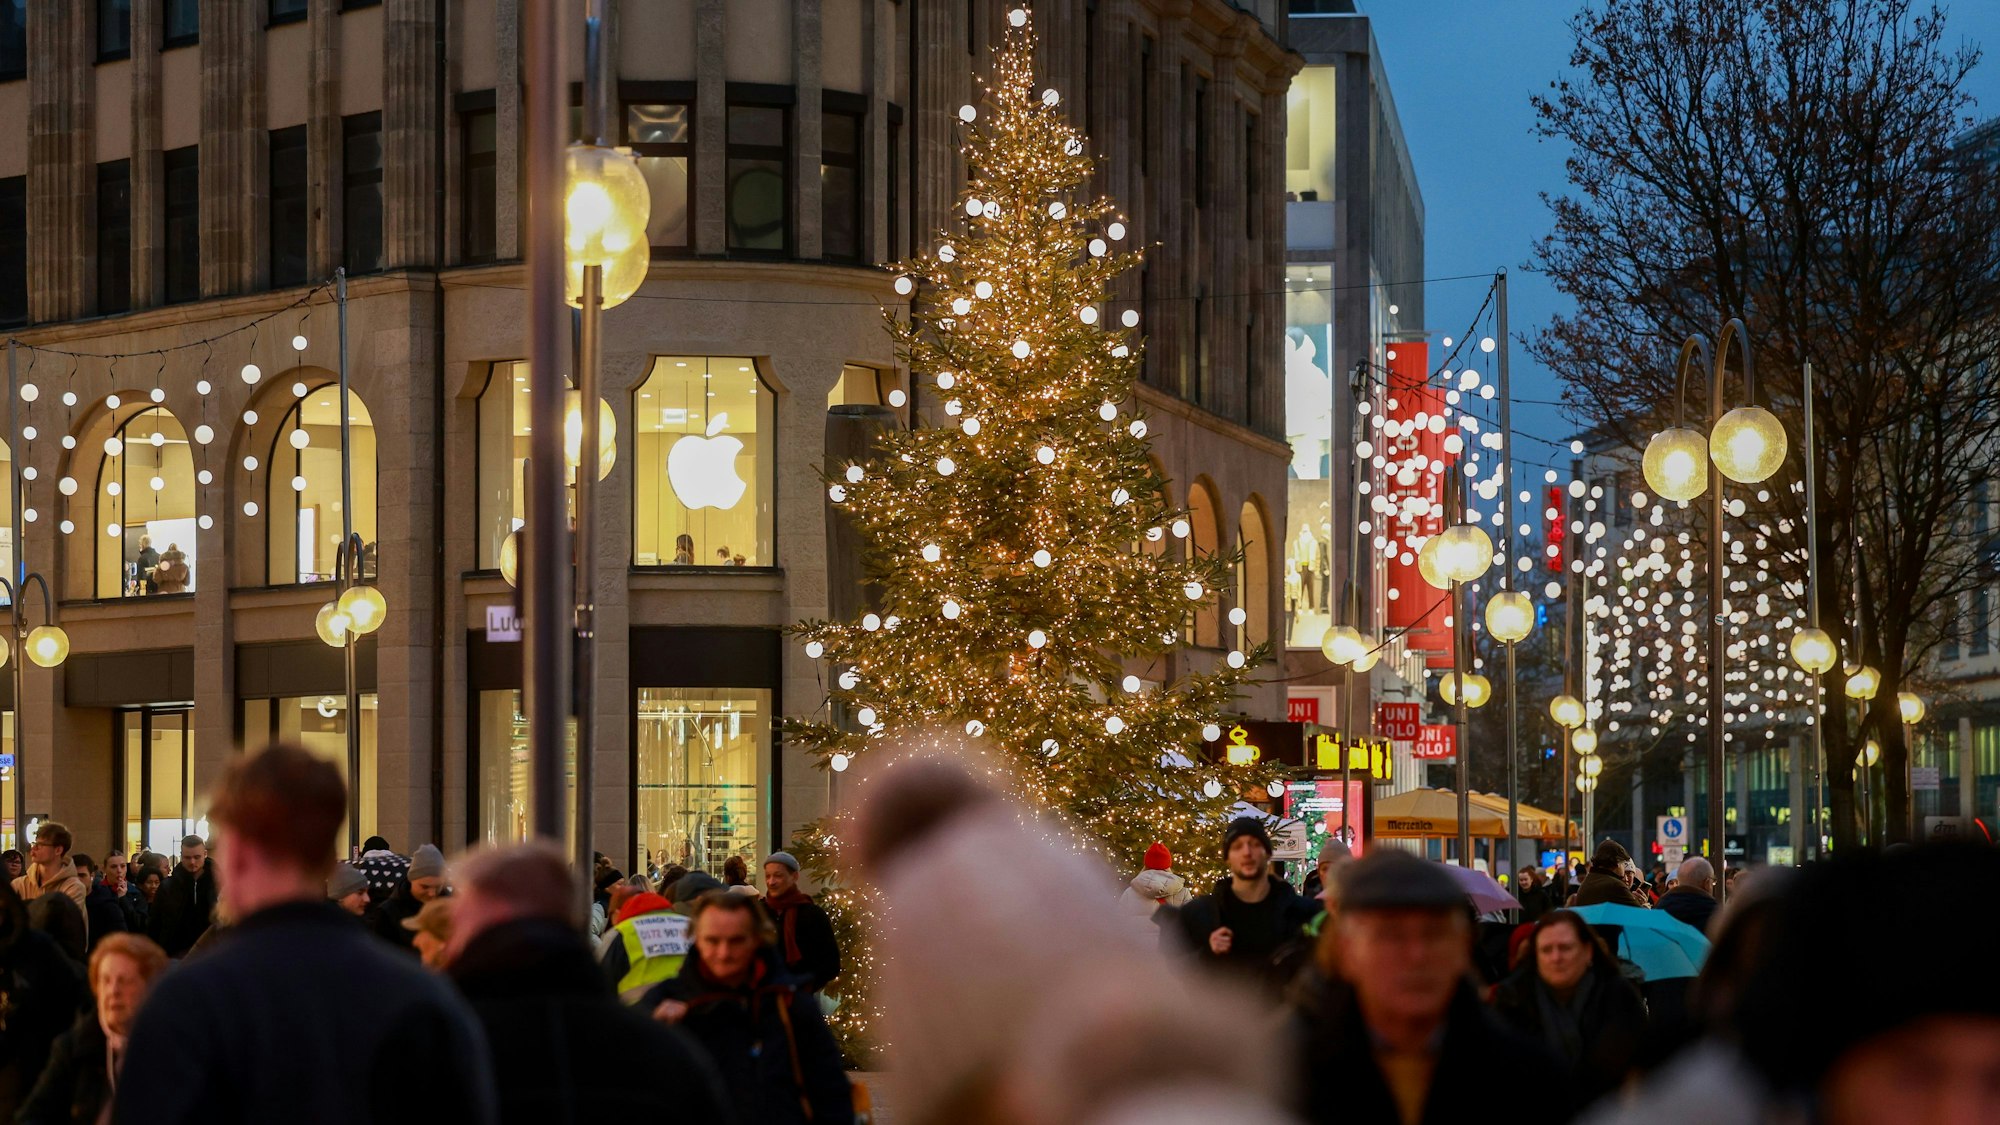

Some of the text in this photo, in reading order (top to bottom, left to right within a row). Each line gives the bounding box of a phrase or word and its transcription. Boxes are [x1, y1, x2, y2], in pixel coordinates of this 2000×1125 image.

[1385, 707, 1413, 721] UNI
[1385, 723, 1416, 738] QLO
[1416, 742, 1443, 757] QLO
